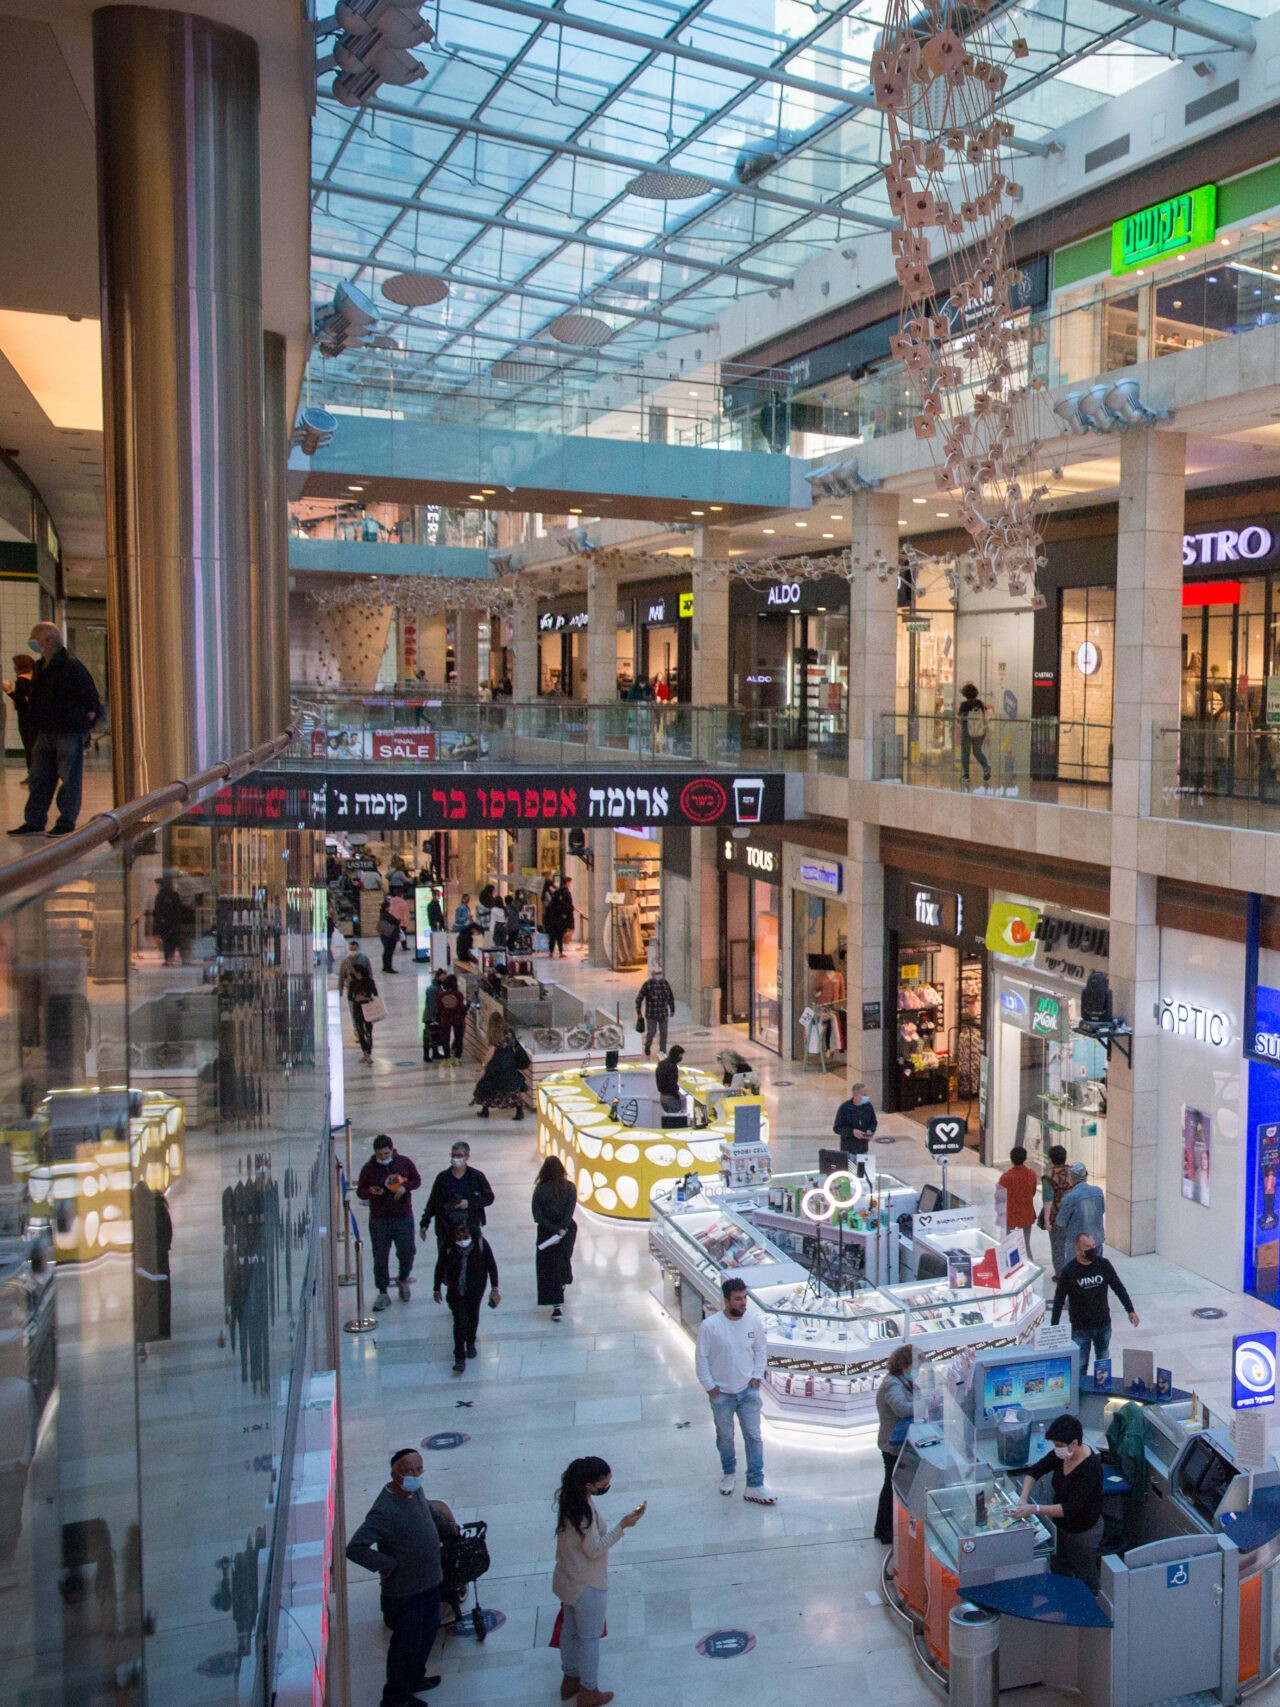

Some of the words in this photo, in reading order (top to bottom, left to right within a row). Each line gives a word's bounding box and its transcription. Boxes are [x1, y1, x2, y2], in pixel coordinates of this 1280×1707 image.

[1123, 194, 1193, 257] ריקושט
[1182, 526, 1272, 566] STRO
[768, 583, 800, 605] ALDO
[746, 675, 773, 683] ALDO
[379, 745, 430, 758] SALE
[354, 793, 408, 821] קומה
[432, 787, 467, 819] בר
[476, 787, 577, 818] אספרסו
[588, 786, 669, 817] ארומה
[746, 846, 773, 871] TOUS
[915, 891, 937, 926] fix
[1077, 1274, 1104, 1288] VINO
